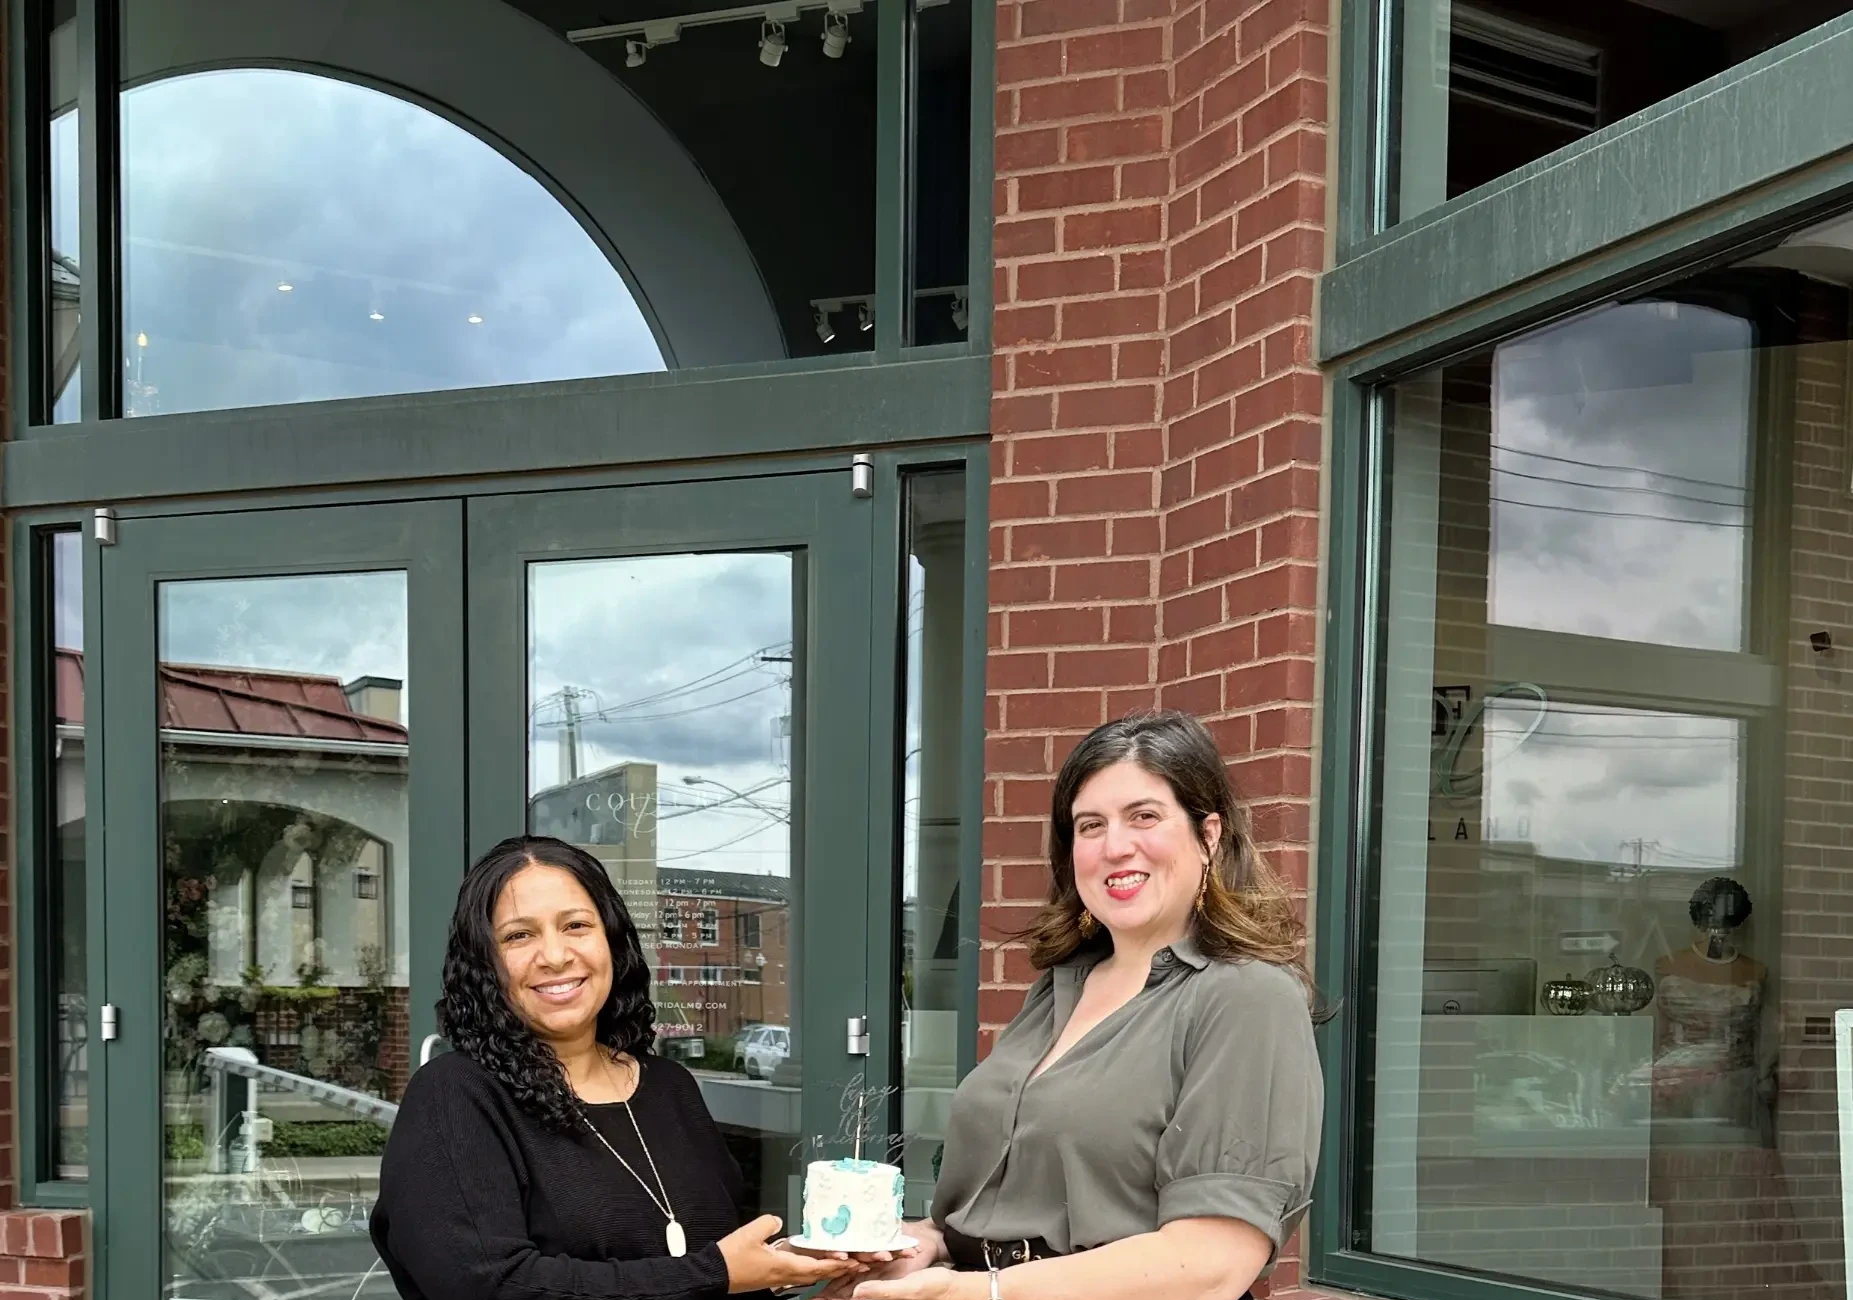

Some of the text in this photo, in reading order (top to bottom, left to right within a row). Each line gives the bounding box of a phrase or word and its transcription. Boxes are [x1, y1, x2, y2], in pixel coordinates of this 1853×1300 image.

[660, 878, 671, 886] 12
[694, 877, 700, 885] 7
[665, 899, 675, 907] 12
[676, 900, 689, 909] pm
[696, 898, 701, 907] 7
[703, 900, 716, 909] pm
[654, 910, 663, 919] 12
[665, 912, 678, 920] pm
[684, 910, 690, 919] 6
[692, 912, 704, 921] pm
[666, 942, 703, 950] MONDAY
